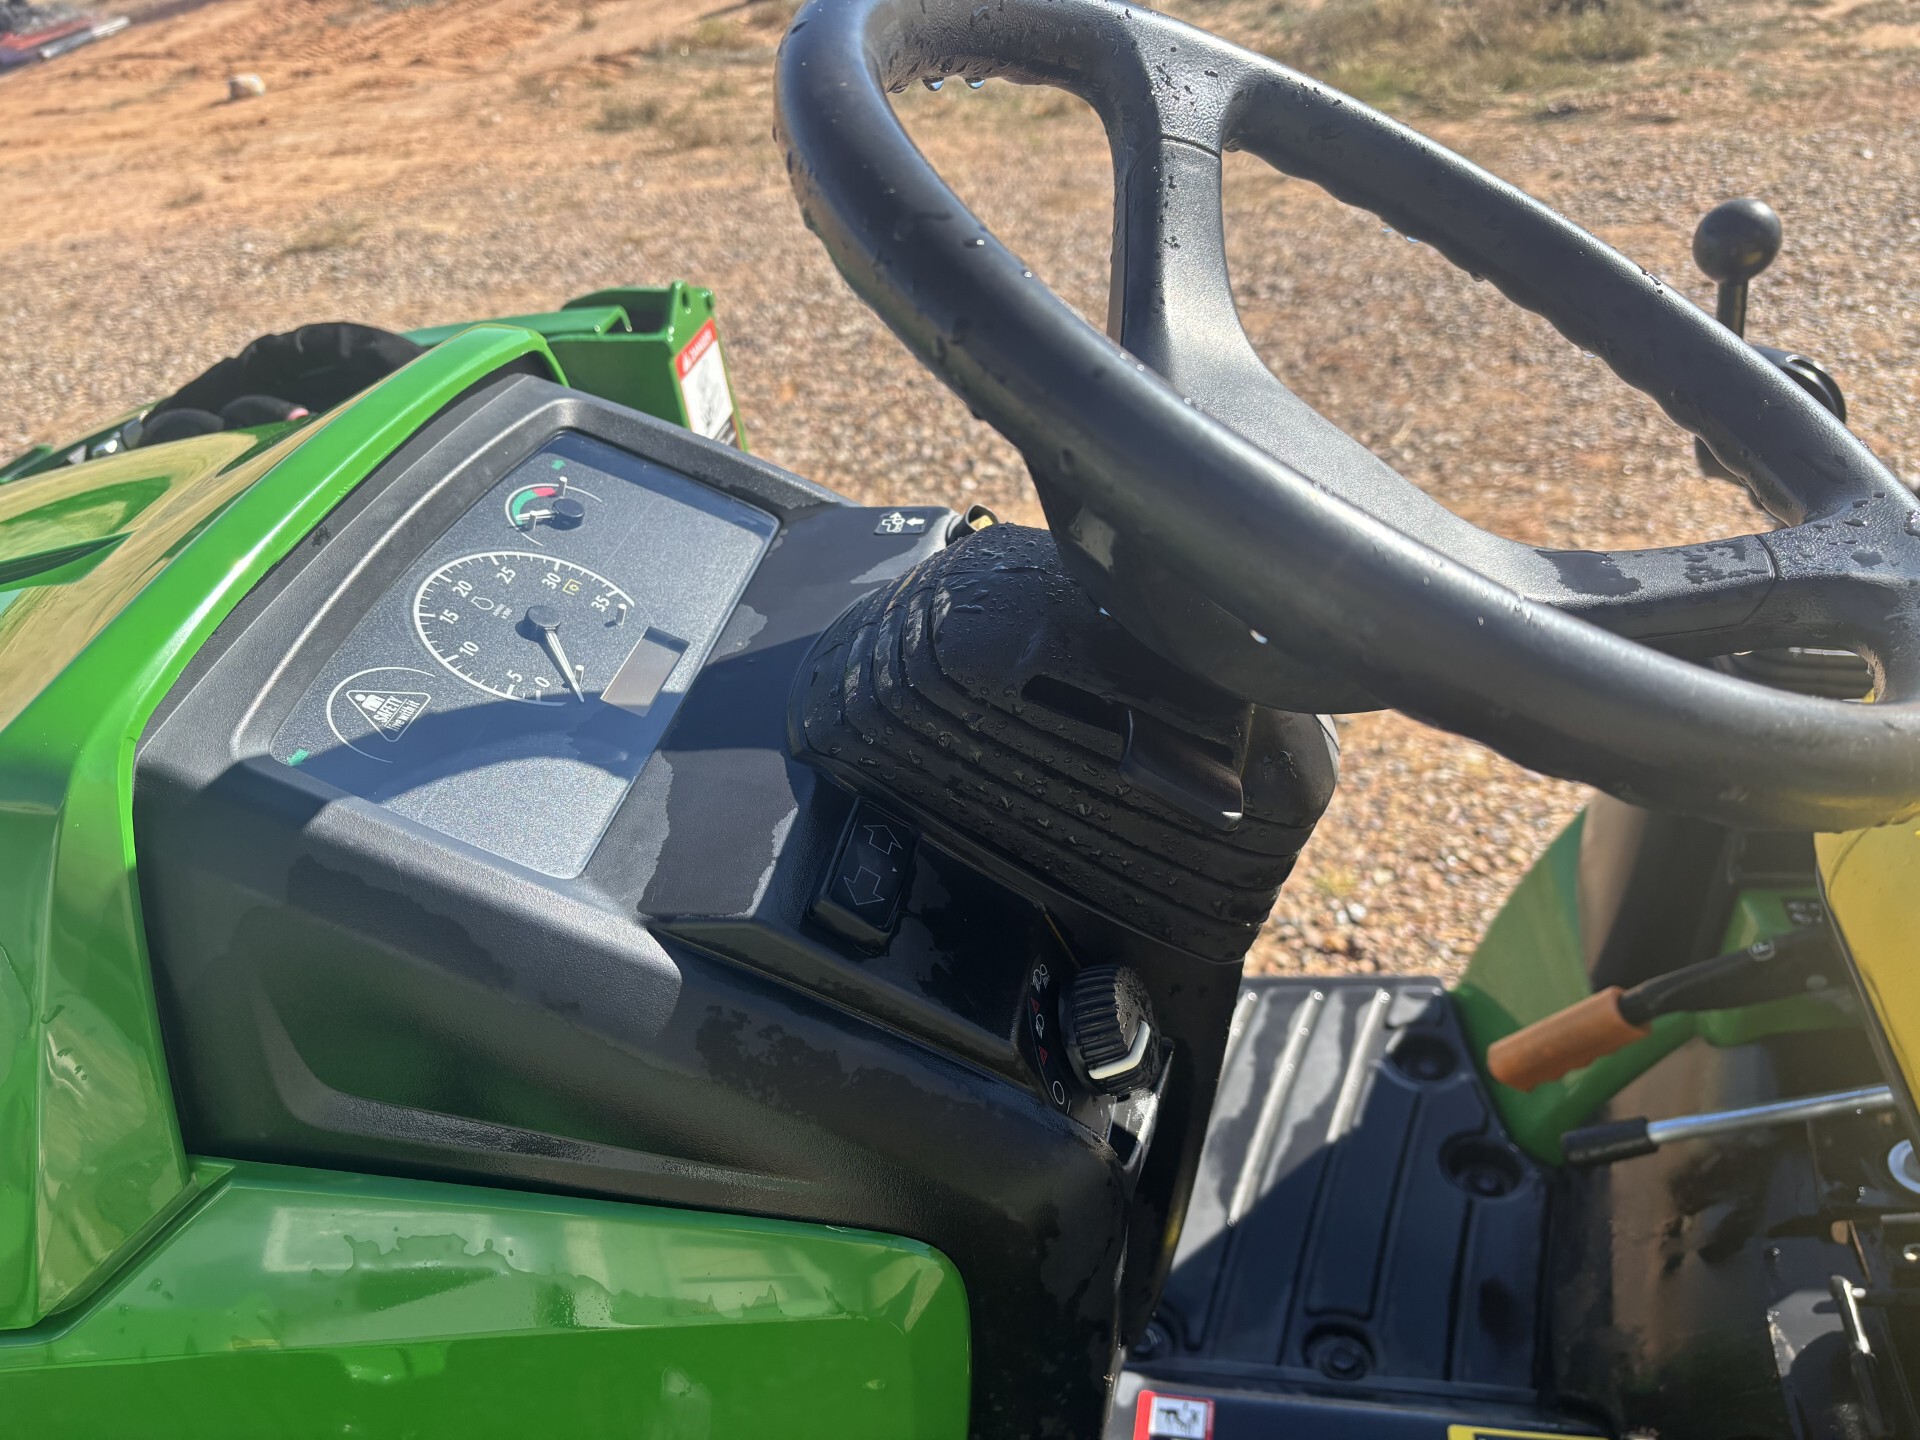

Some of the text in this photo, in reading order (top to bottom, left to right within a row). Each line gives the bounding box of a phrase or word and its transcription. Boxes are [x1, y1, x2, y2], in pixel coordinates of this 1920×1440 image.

[497, 566, 516, 584] 25
[541, 572, 561, 590] 30
[452, 580, 473, 598] 20
[591, 595, 610, 613] 35
[439, 608, 459, 625] 15
[459, 641, 479, 656] 10
[506, 670, 522, 683] 5
[534, 676, 551, 688] 0
[373, 695, 402, 723] SAFETY
[397, 705, 417, 721] with
[406, 700, 421, 709] it
